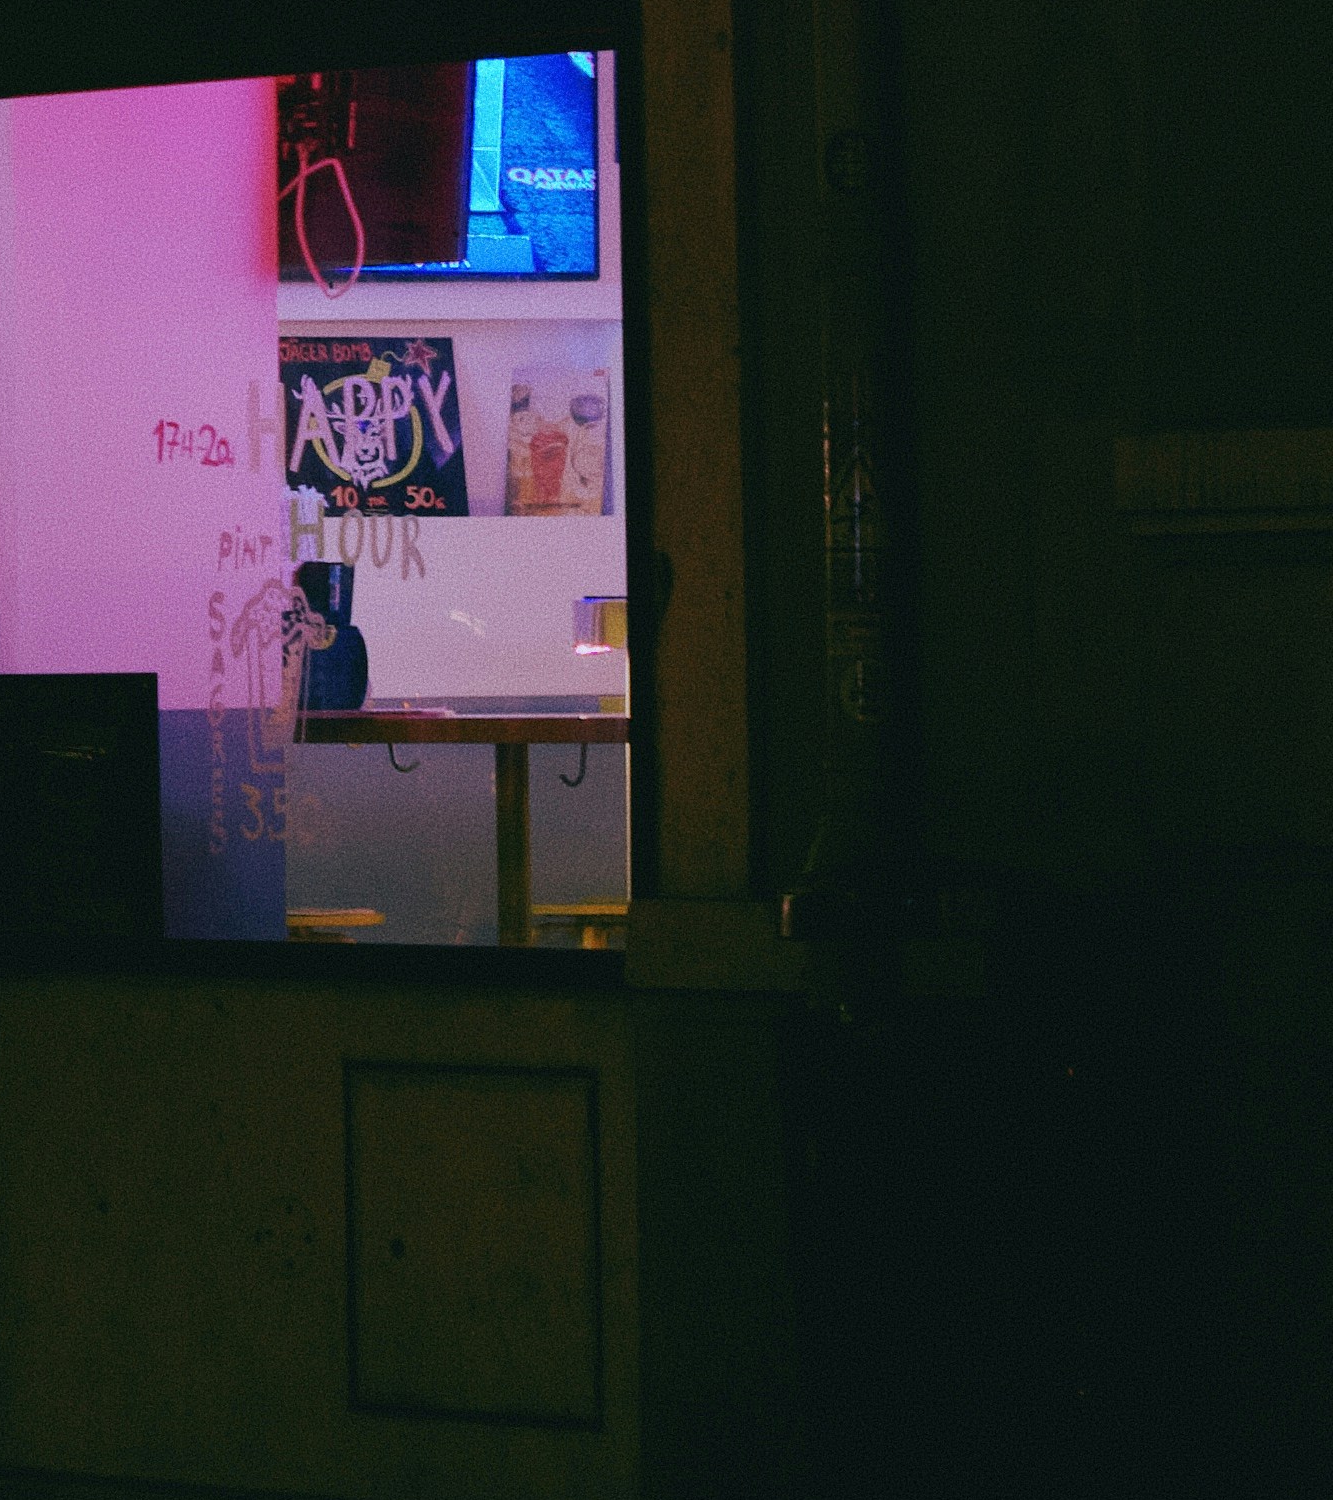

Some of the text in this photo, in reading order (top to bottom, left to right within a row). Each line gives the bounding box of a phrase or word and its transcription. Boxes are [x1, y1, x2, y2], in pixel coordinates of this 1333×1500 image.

[333, 342, 373, 362] BOMB
[247, 370, 455, 473] HAPPY
[330, 485, 359, 509] 10
[290, 500, 426, 580] HOUR
